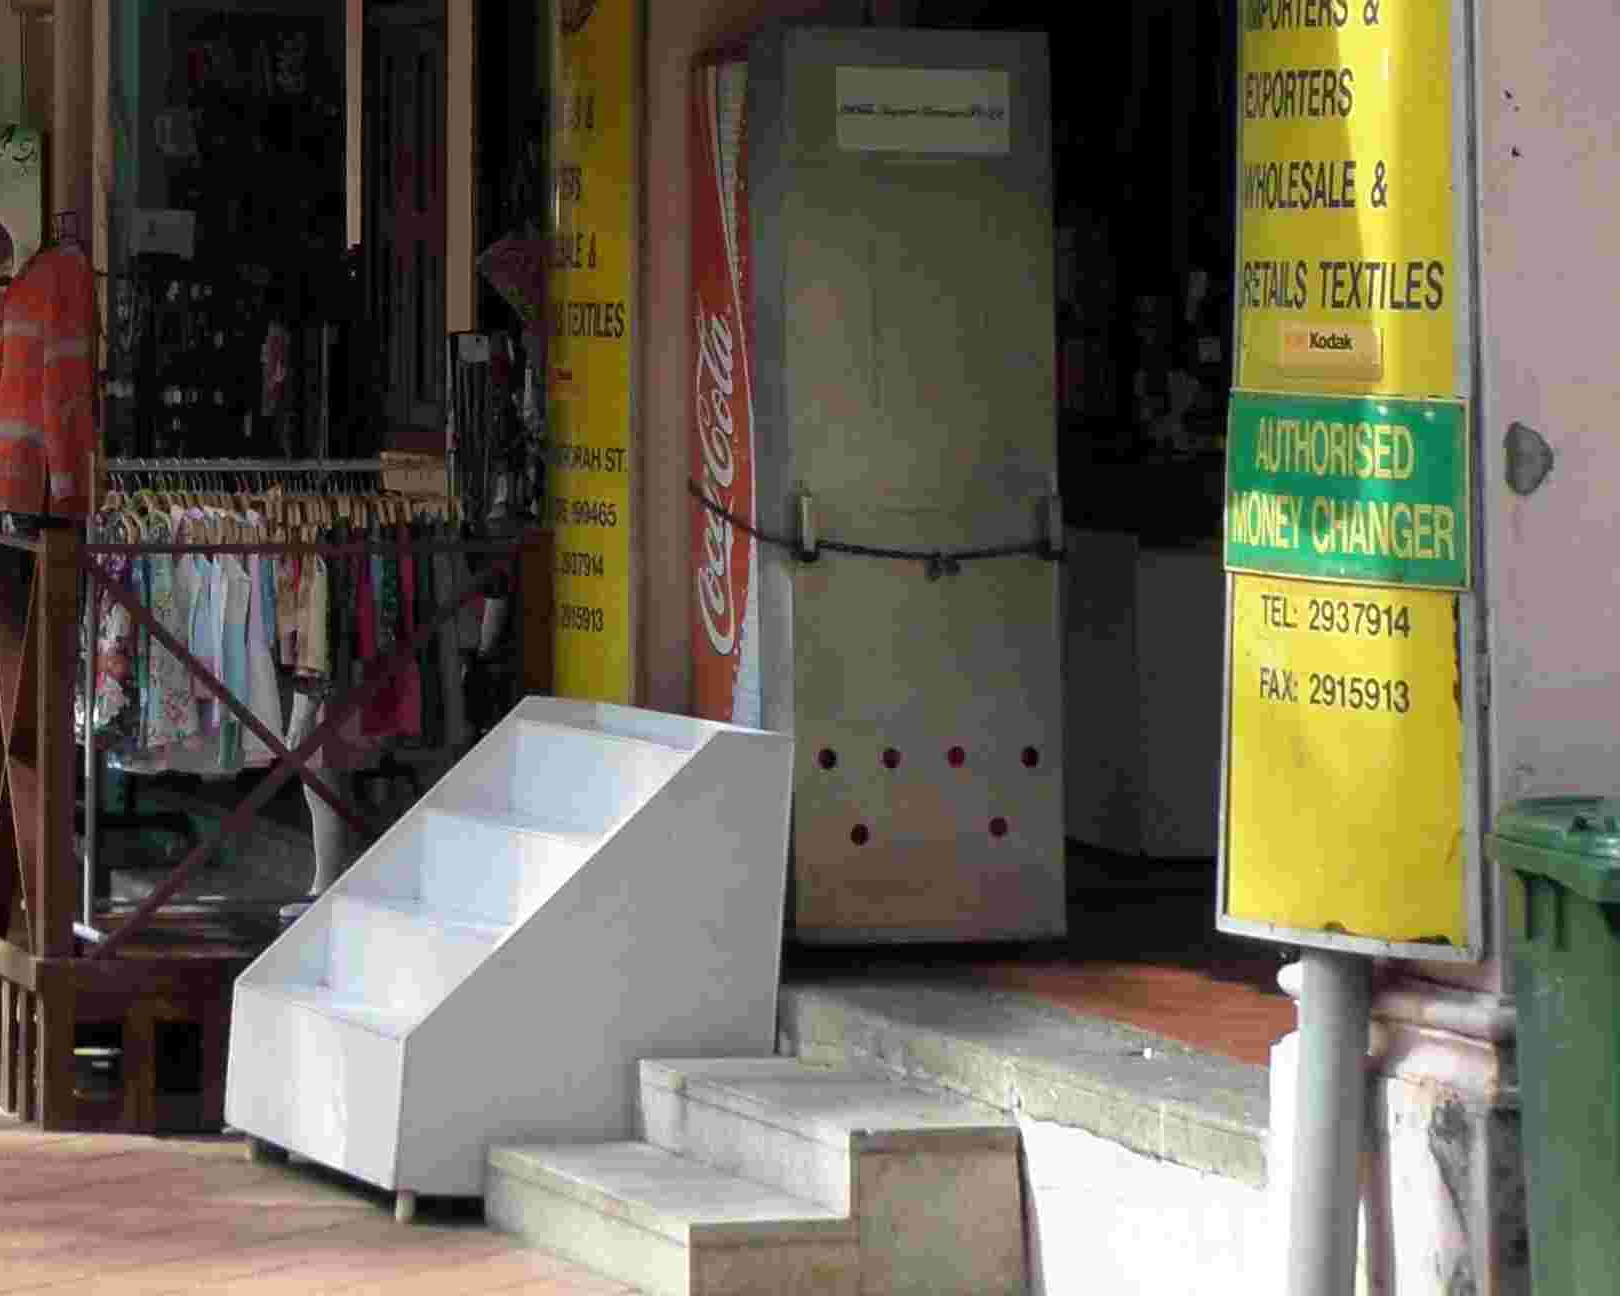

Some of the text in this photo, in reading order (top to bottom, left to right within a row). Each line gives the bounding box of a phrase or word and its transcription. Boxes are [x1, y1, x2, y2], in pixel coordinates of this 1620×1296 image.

[1371, 158, 1388, 209] &
[1318, 260, 1446, 312] TEXTILES
[1308, 330, 1354, 351] Kodak
[1256, 416, 1417, 480] AUTHORISED
[1231, 491, 1456, 561] MONEY CHANGER
[1261, 594, 1412, 638] TEL: 2937914
[1259, 666, 1411, 713] FAX: 2915913
